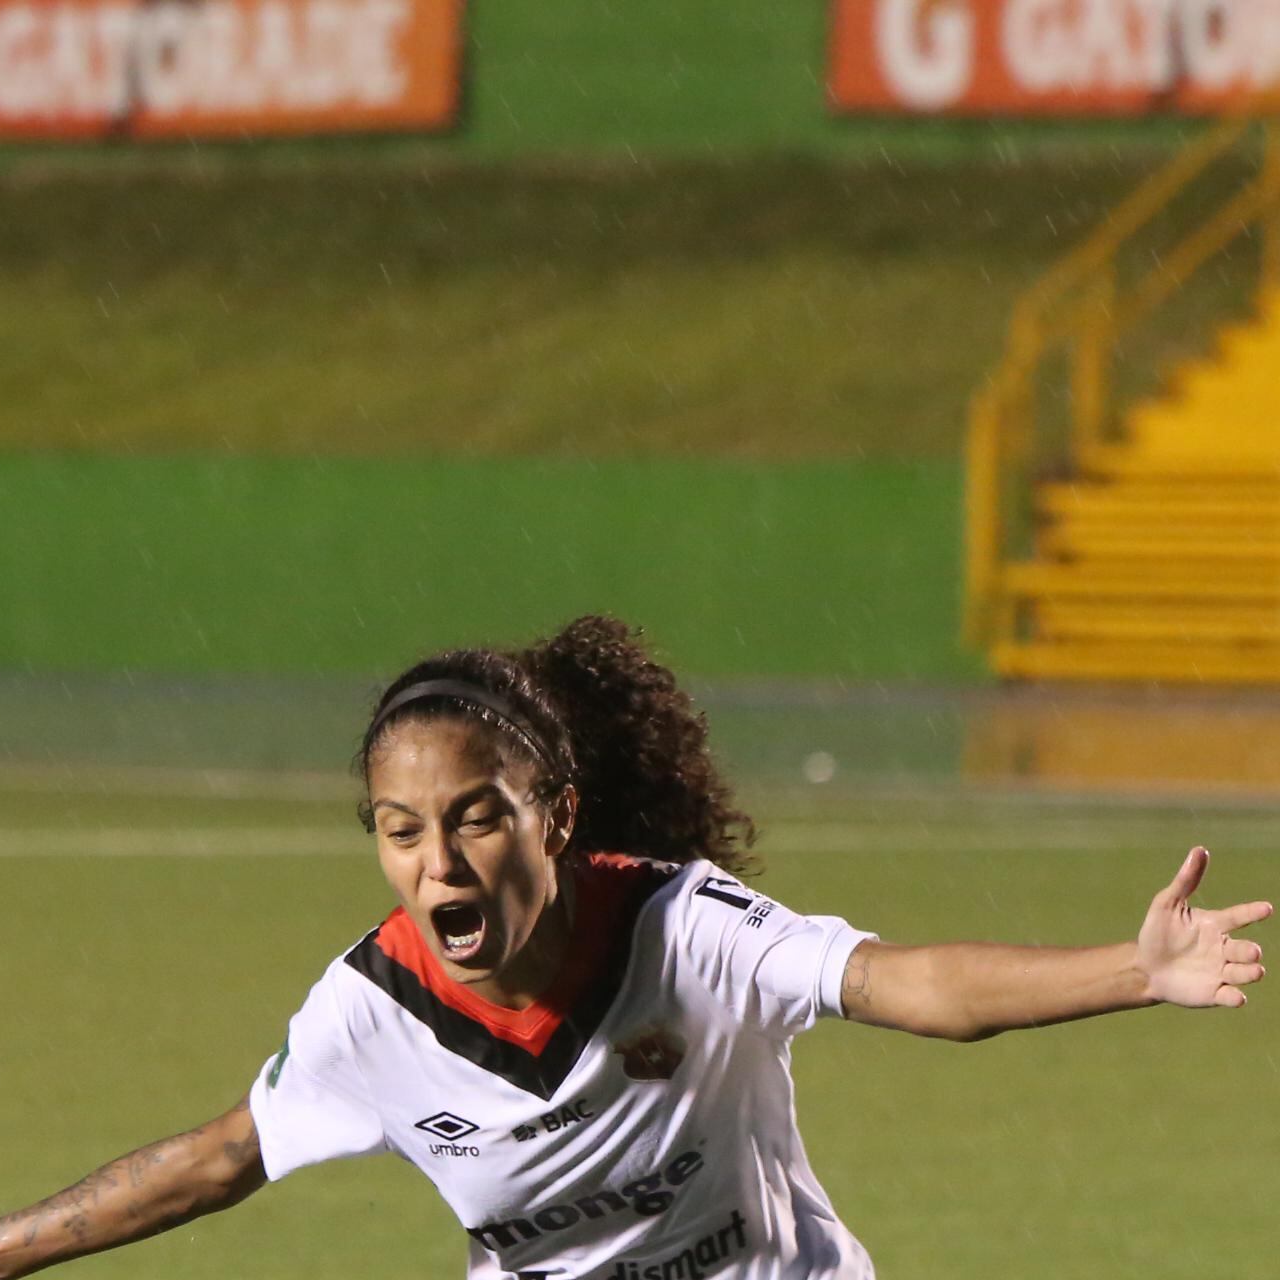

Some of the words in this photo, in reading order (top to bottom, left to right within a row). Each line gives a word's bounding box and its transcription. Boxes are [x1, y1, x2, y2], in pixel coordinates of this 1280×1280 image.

[873, 0, 975, 110] G
[540, 1099, 596, 1133] BAC
[429, 1142, 480, 1158] umbro
[466, 1151, 706, 1251] monge
